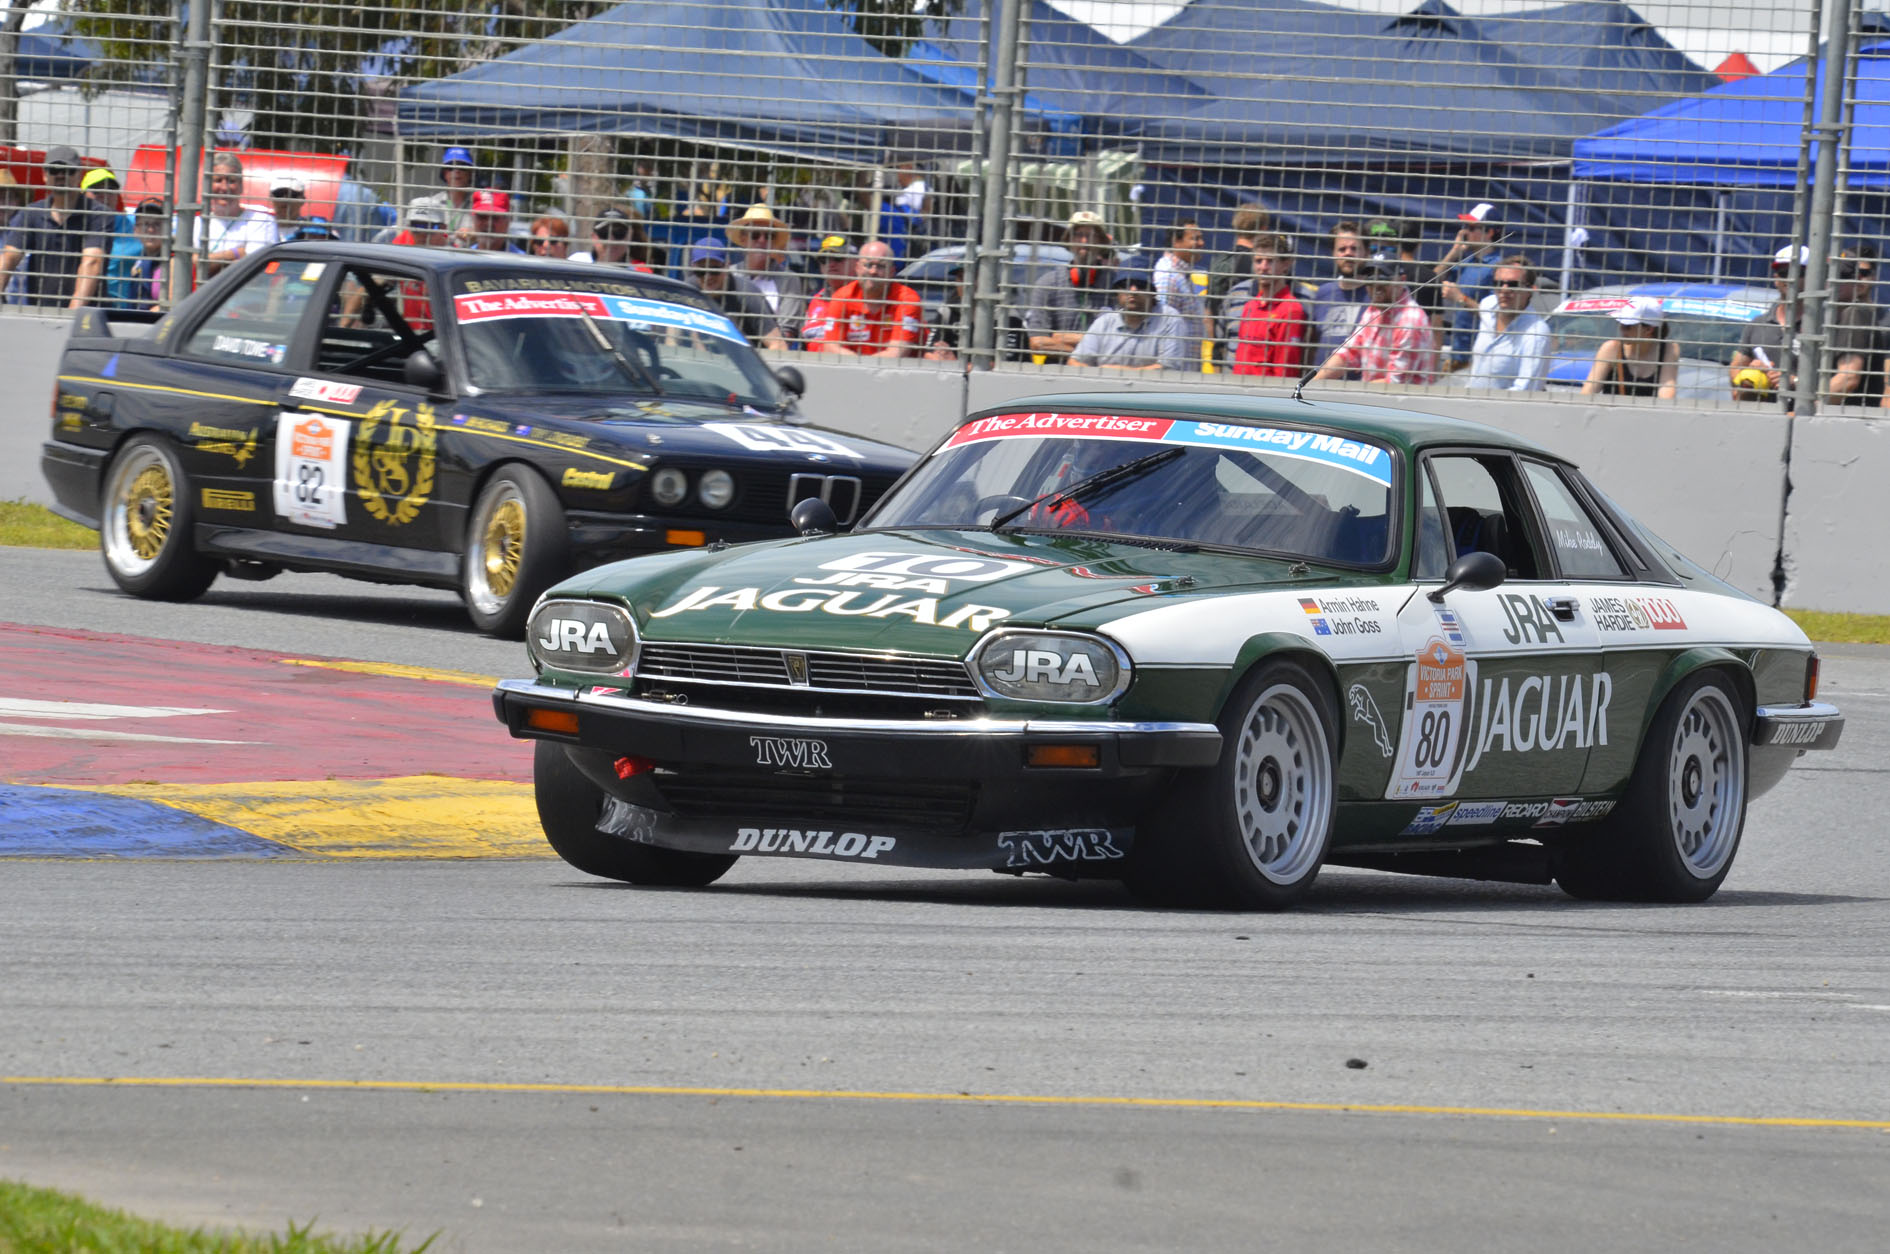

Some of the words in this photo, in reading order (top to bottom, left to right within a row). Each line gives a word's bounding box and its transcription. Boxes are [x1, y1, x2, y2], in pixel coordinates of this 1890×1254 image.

[461, 297, 503, 314] The
[504, 296, 598, 314] Advertiser
[968, 415, 1018, 437] The
[1015, 413, 1157, 432] Advertiser
[1194, 421, 1317, 451] Sunday
[1309, 433, 1381, 465] Mail
[296, 463, 325, 505] 82
[845, 554, 992, 577] 10
[793, 571, 950, 595] JRA
[649, 585, 1012, 632] JAGUAR
[1318, 597, 1350, 614] Armin
[1345, 596, 1380, 613] Hahne
[1590, 598, 1627, 614] JAMES
[1330, 617, 1357, 636] John
[1354, 616, 1382, 634] Goss
[1496, 593, 1566, 645] JRA
[1593, 614, 1637, 632] HARDIE
[538, 618, 619, 656] JRA
[993, 649, 1102, 688] JRA
[1420, 663, 1446, 682] VICTORIA
[1447, 664, 1464, 681] PARK
[1429, 681, 1453, 699] SPRINT
[1465, 671, 1614, 773] JAGUAR
[1769, 722, 1826, 744] DUNLOP
[750, 735, 833, 768] TWR
[1414, 710, 1451, 769] 80
[1453, 805, 1502, 821] speedline
[1501, 802, 1549, 818] RECARO
[1572, 800, 1617, 817] BILSTEIN
[728, 828, 897, 859] DUNLOP
[997, 828, 1125, 867] TWR
